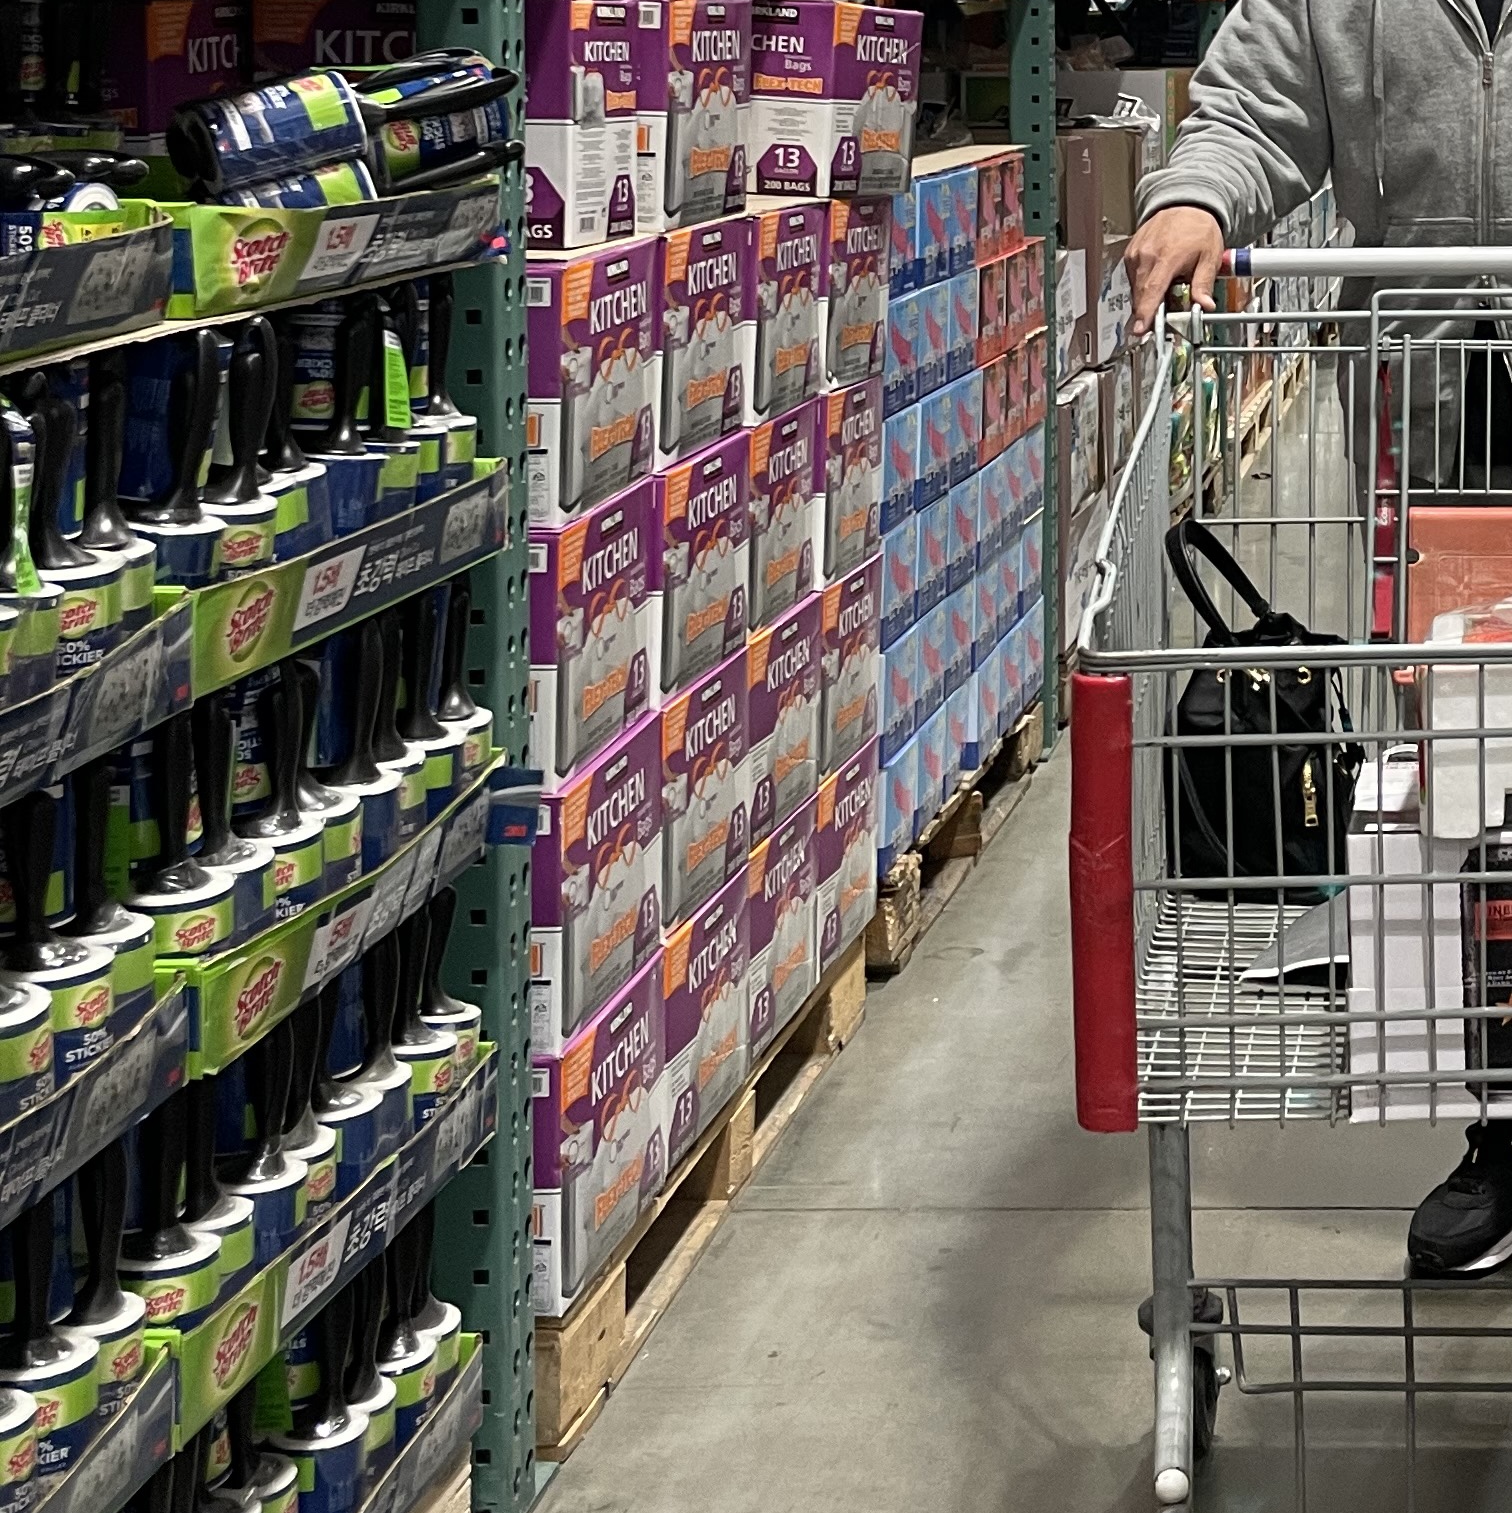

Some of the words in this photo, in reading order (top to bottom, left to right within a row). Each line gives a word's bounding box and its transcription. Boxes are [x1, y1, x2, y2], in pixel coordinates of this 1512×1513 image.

[584, 41, 630, 63] KITCHEN
[692, 30, 741, 62] KITCHEN
[784, 59, 812, 72] Bags
[774, 147, 801, 168] 13
[841, 141, 856, 166] 13
[784, 180, 811, 192] BAGS
[233, 232, 292, 261] Scotch
[776, 233, 818, 273] KITCHEN
[846, 224, 884, 256] KITCHEN
[688, 251, 738, 297] KITCHEN
[590, 280, 648, 336] KITCHEN
[841, 406, 876, 446] KITCHEN
[768, 437, 809, 486] KITCHEN
[688, 473, 738, 531] KITCHEN
[582, 527, 639, 596] KITCHEN
[838, 591, 875, 640] KITCHEN
[766, 635, 811, 694] KITCHEN
[685, 693, 737, 763] KITCHEN
[587, 767, 646, 852] KITCHEN
[763, 843, 806, 903] KITCHEN
[688, 919, 738, 994] KITCHEN
[757, 990, 770, 1019] 13
[591, 1010, 651, 1108] KITCHEN
[679, 1090, 694, 1126] 13
